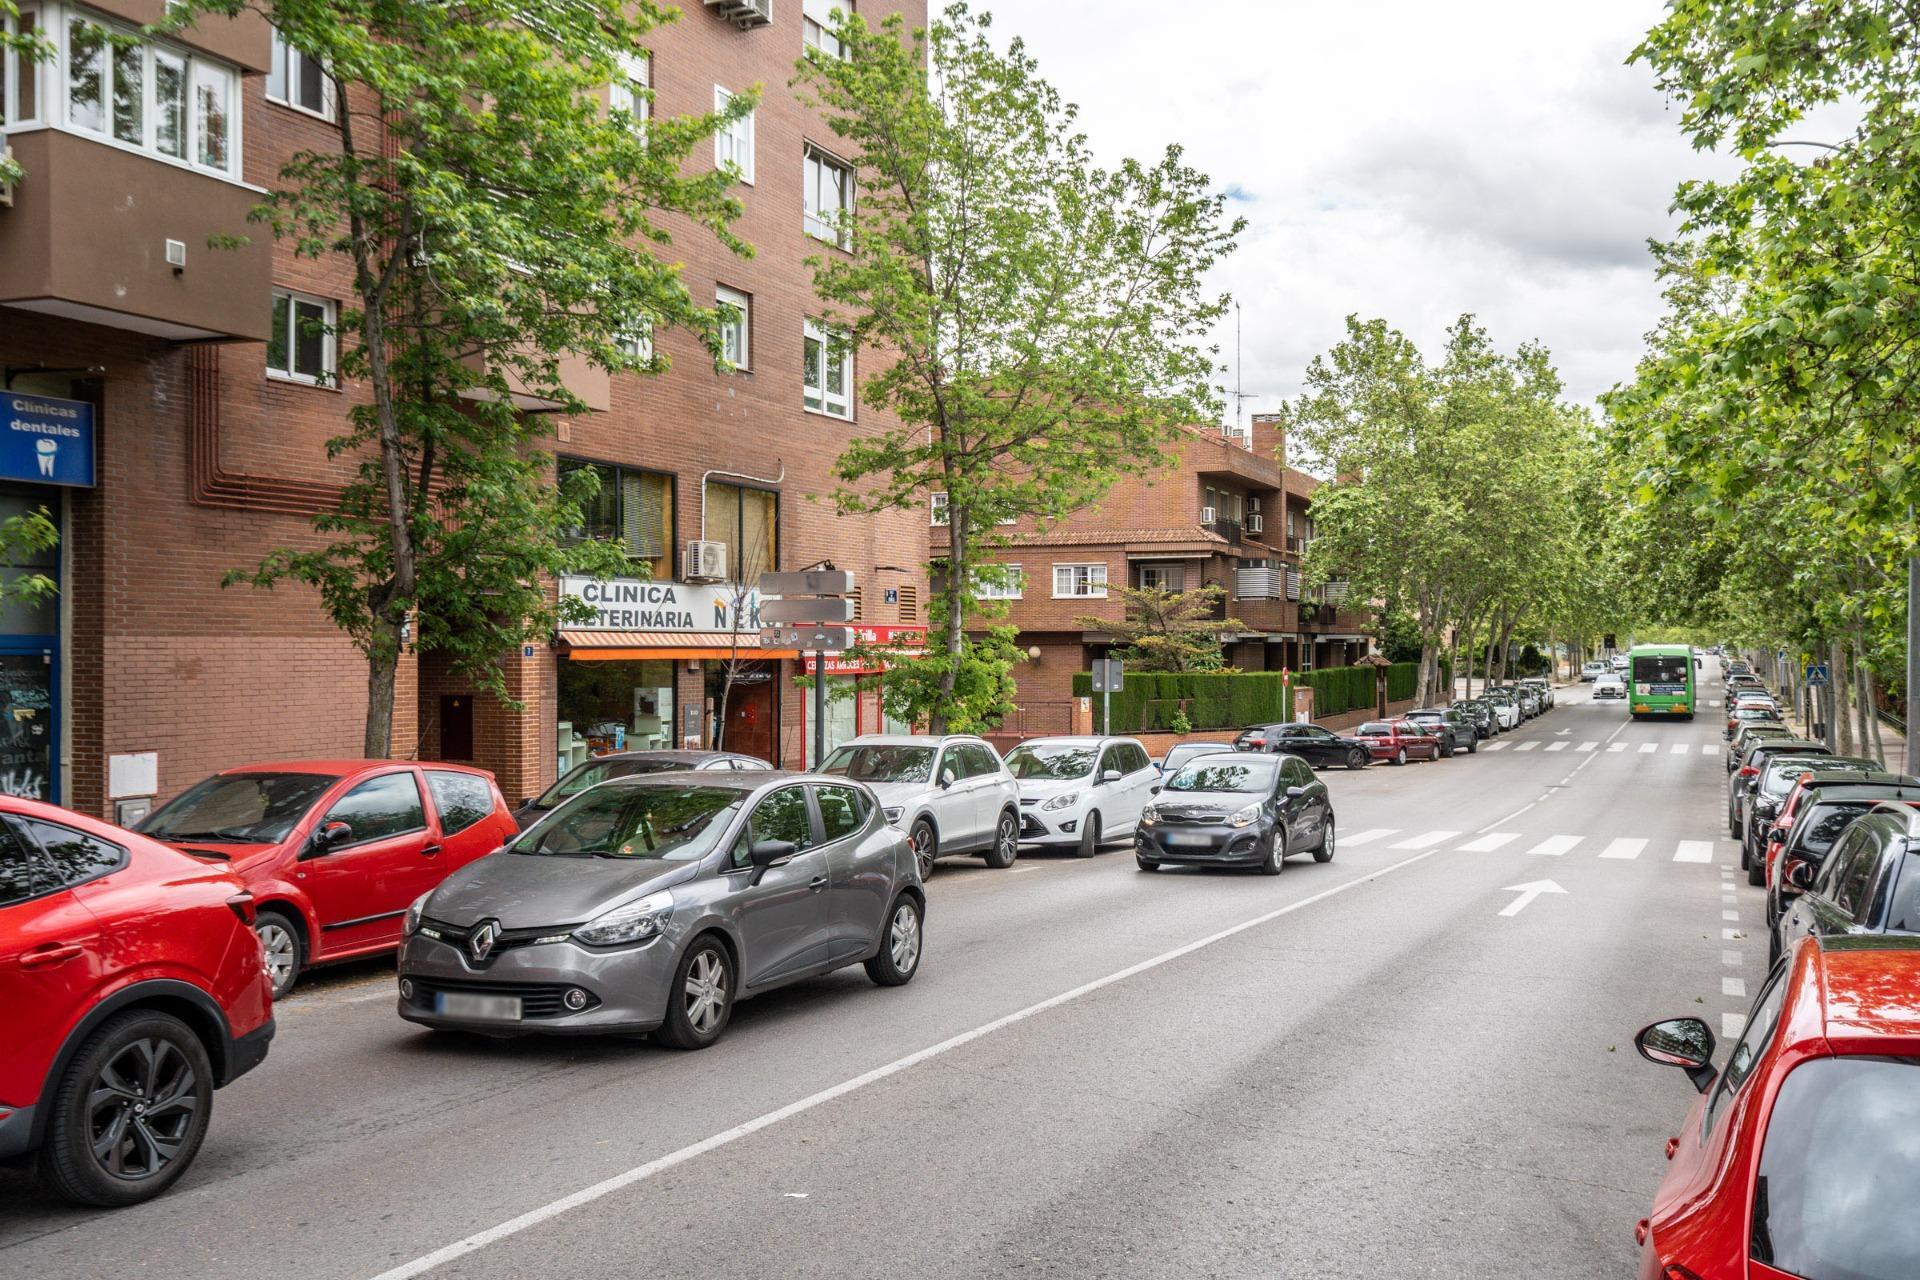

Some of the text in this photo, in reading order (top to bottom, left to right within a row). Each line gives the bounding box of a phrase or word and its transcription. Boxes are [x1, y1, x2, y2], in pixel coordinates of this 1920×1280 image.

[12, 399, 77, 418] Clínicas
[10, 419, 80, 438] dentales
[583, 584, 677, 604] CLINICA
